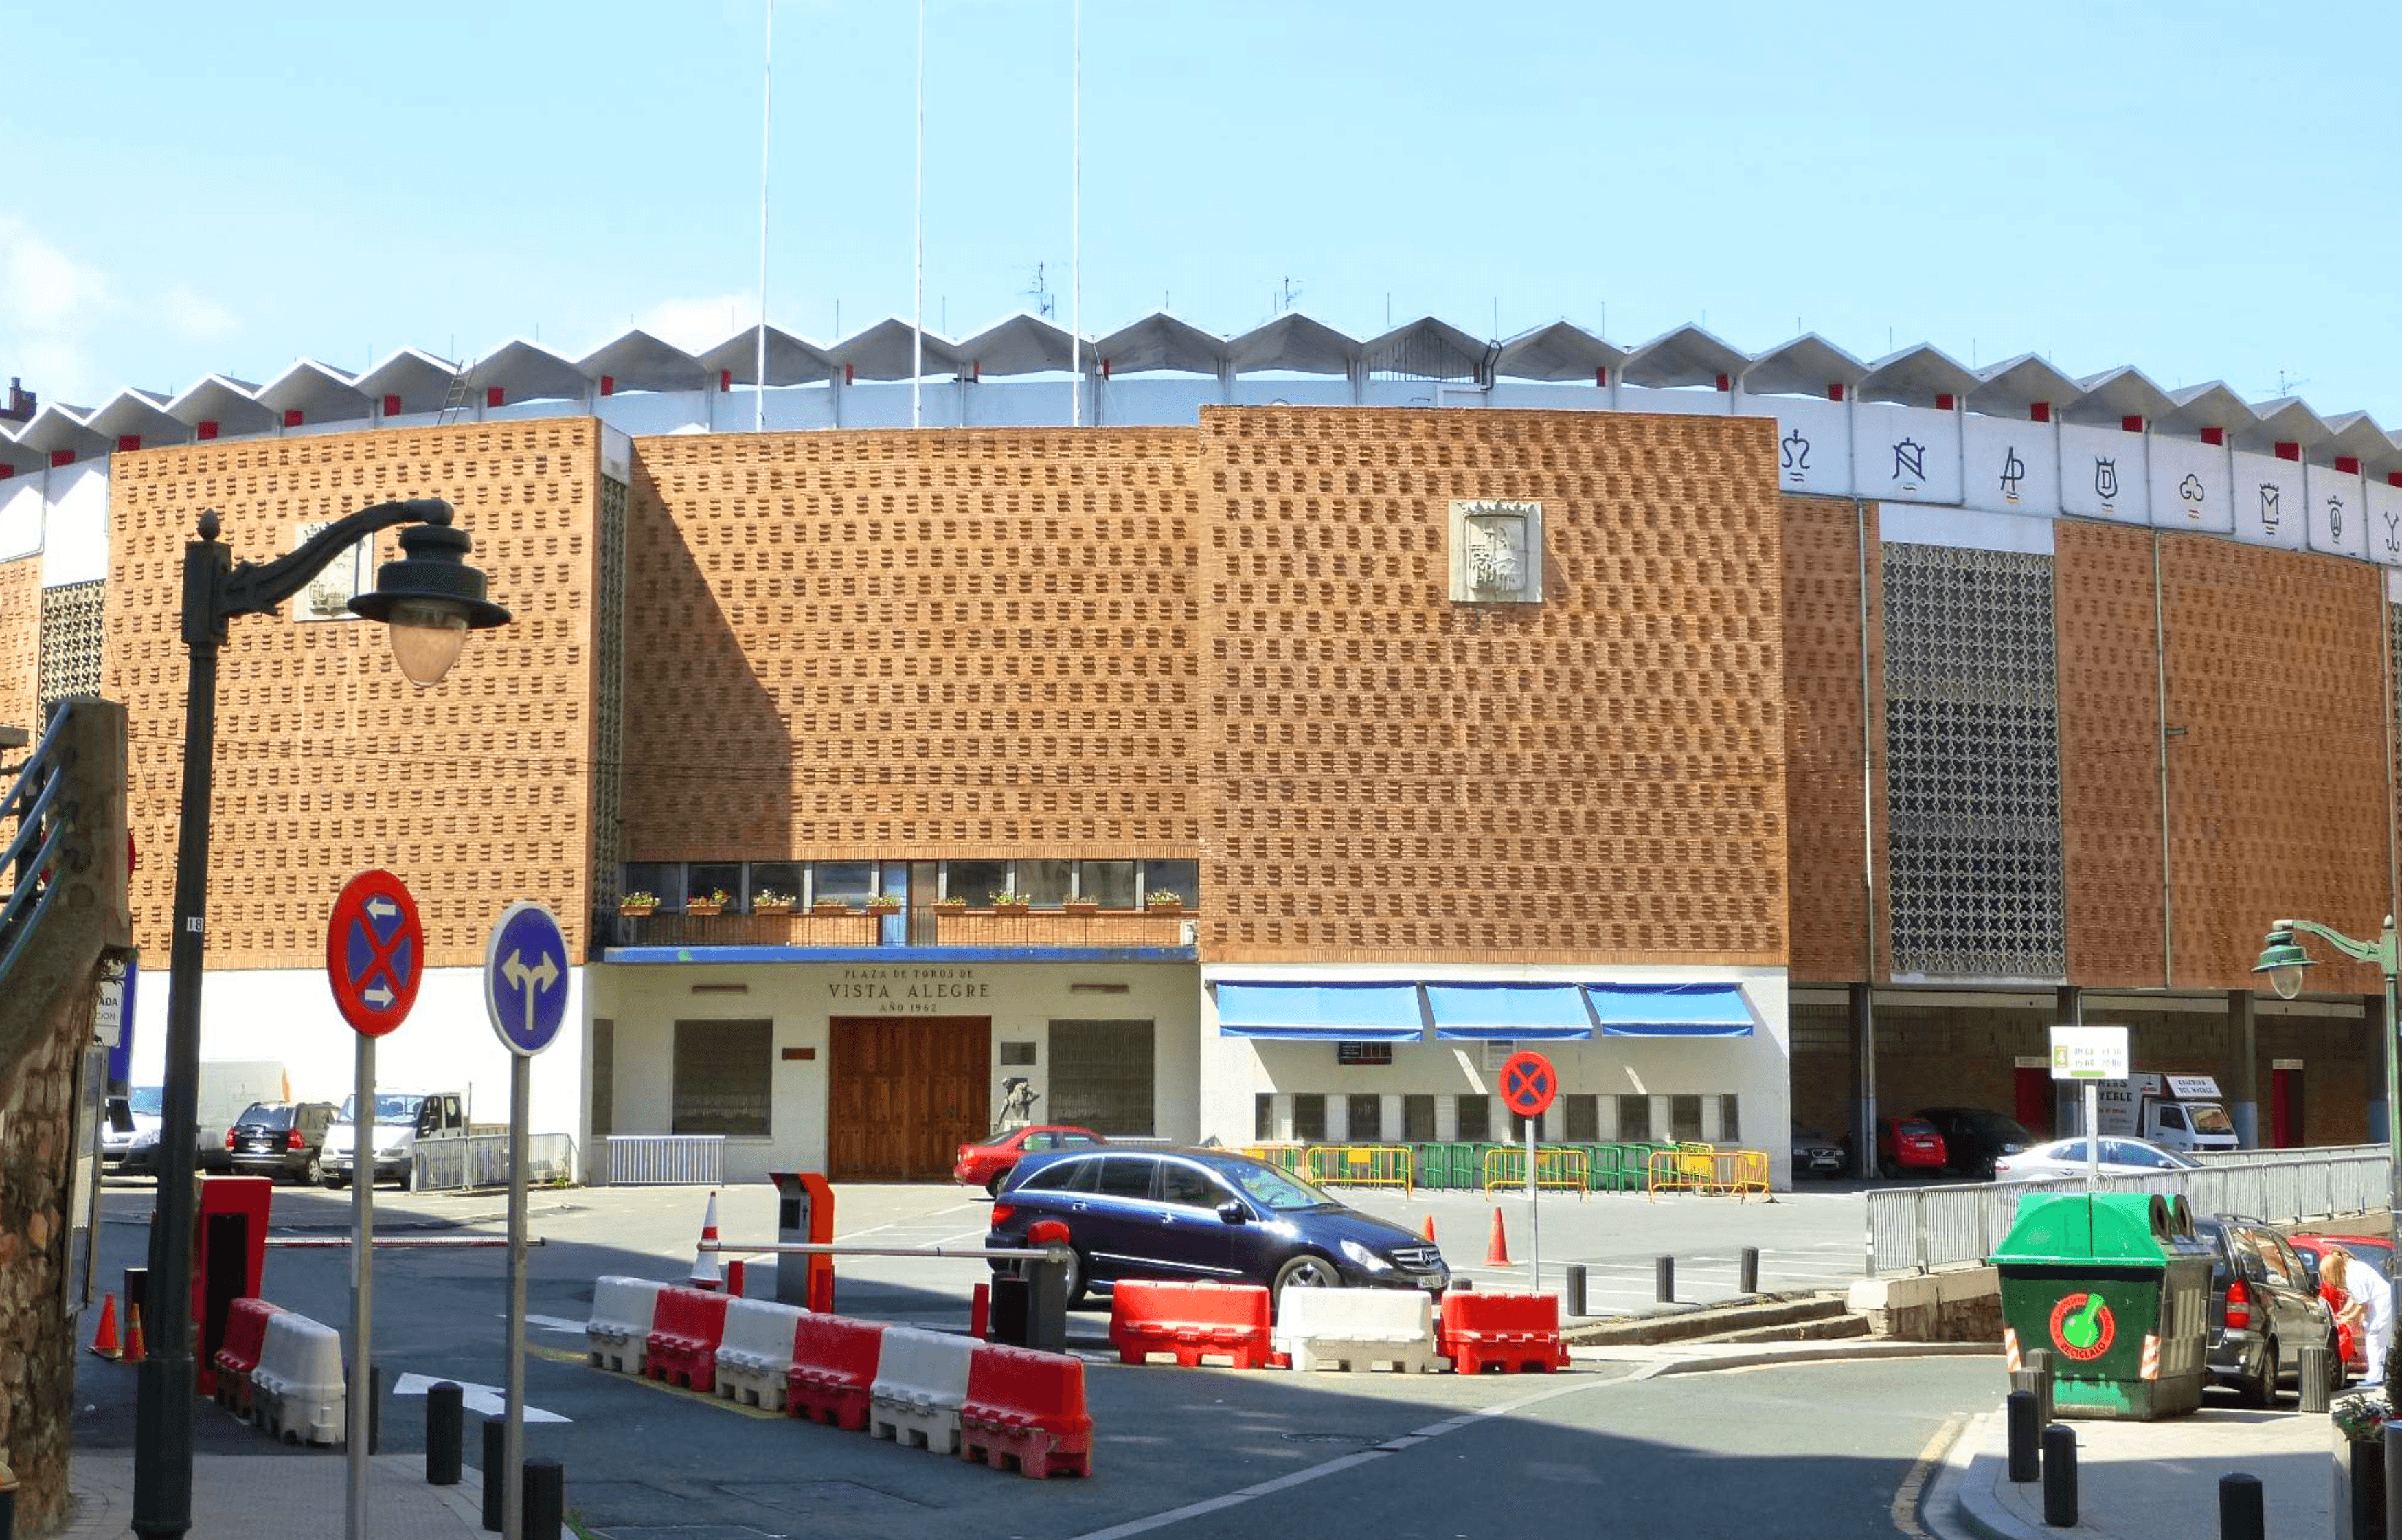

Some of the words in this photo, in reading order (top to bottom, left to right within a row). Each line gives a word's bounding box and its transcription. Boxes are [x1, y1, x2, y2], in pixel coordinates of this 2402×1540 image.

[844, 969, 887, 980] PLAZA
[894, 969, 907, 979] DE
[914, 969, 954, 979] TOROS
[960, 969, 974, 979] DE
[830, 984, 890, 998] VISTA
[907, 984, 990, 998] ALEGRE
[879, 1001, 904, 1013] AÑO
[911, 1003, 937, 1013] 1962
[2061, 1342, 2105, 1358] RECICLALO
